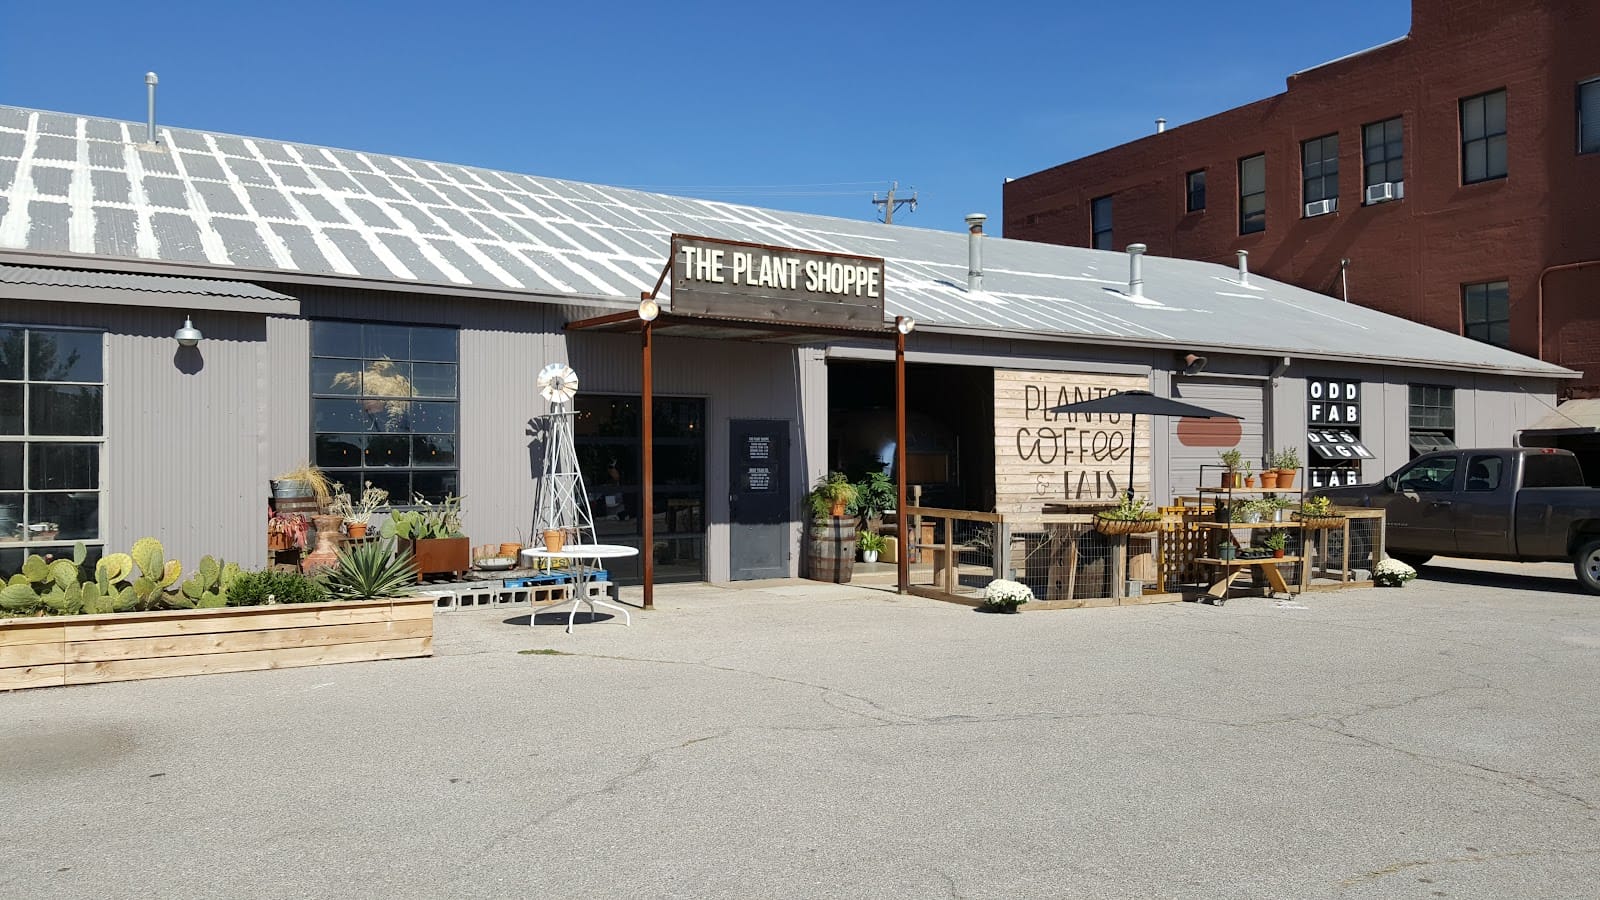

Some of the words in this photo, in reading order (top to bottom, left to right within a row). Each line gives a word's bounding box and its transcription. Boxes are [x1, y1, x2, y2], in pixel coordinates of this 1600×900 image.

[682, 246, 725, 284] THE
[732, 252, 800, 290] PLANT
[805, 259, 880, 298] SHOPPE
[1310, 381, 1357, 400] ODD
[1311, 404, 1357, 422] FAB
[1036, 474, 1050, 496] &
[1063, 470, 1118, 500] EATS
[1312, 470, 1357, 487] LAB
